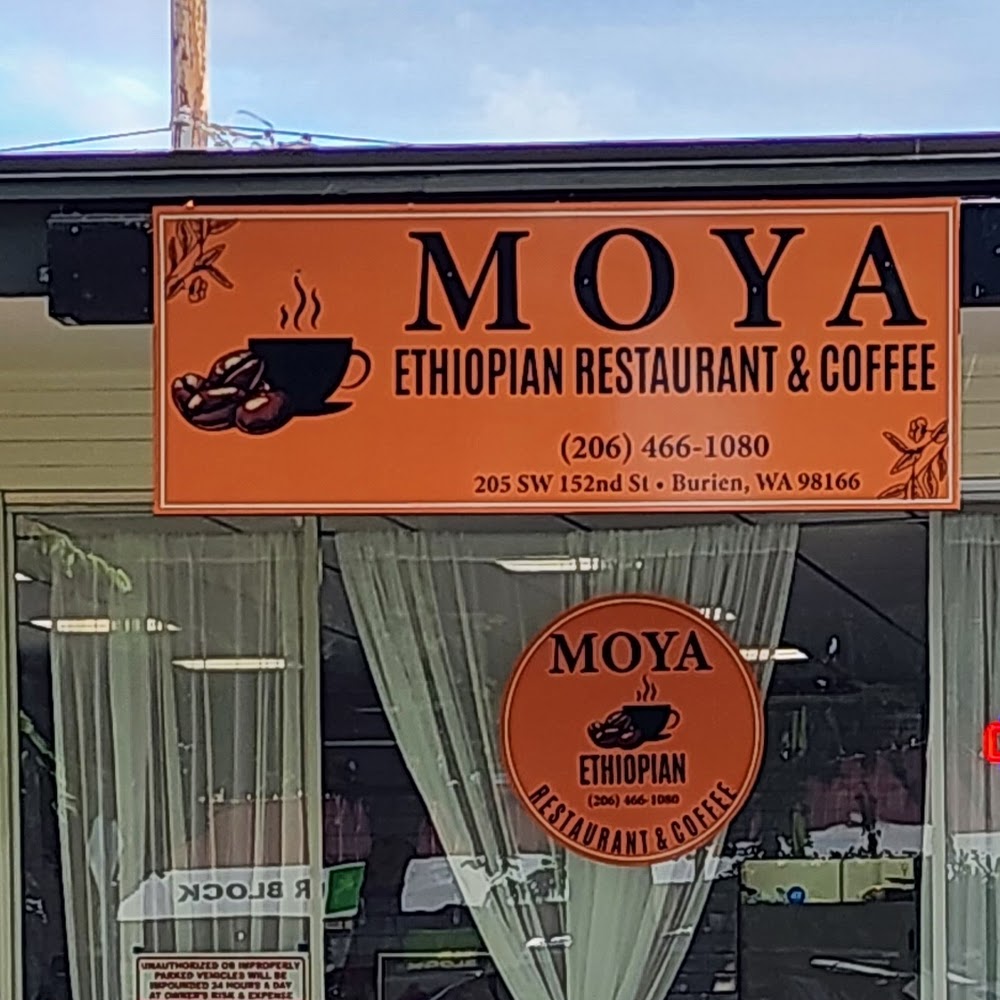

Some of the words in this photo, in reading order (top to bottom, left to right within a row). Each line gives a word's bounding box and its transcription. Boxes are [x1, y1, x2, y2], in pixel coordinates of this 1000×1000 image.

[404, 225, 928, 331] MOYA
[395, 347, 563, 396] ETHIOPIAN
[576, 345, 779, 394] RESTAURANT
[788, 346, 810, 392] &
[820, 343, 936, 391] COFFEE
[560, 433, 632, 464] (206)
[641, 434, 770, 459] 466-1080
[474, 475, 511, 493] 205
[518, 475, 553, 493] SW
[561, 473, 622, 493] 152nd
[629, 474, 649, 492] St
[672, 473, 749, 494] Burien,
[756, 473, 792, 492] WA
[797, 472, 860, 491] 98166
[549, 630, 713, 674] MOYA
[580, 753, 686, 785] ETHIOPIAN
[588, 793, 620, 808] (206)
[624, 794, 680, 806] 466-1080
[528, 784, 648, 854] RESTAURANT
[655, 827, 668, 850] &
[671, 781, 738, 844] COFFEE
[141, 961, 219, 970] UNAUTHORIZED
[238, 961, 300, 970] IMPROPERLY
[154, 971, 194, 980] PARKED
[196, 971, 245, 980] VEHICLES
[248, 971, 272, 980] WILL
[274, 971, 287, 980] BE
[149, 991, 161, 999] AT
[211, 991, 235, 999] RISK
[248, 991, 293, 999] EXPENSE
[150, 982, 209, 990] IMPOUNDED
[211, 982, 224, 990] 24
[226, 982, 261, 990] HOURS
[264, 982, 270, 990] A
[273, 981, 292, 990] DAY
